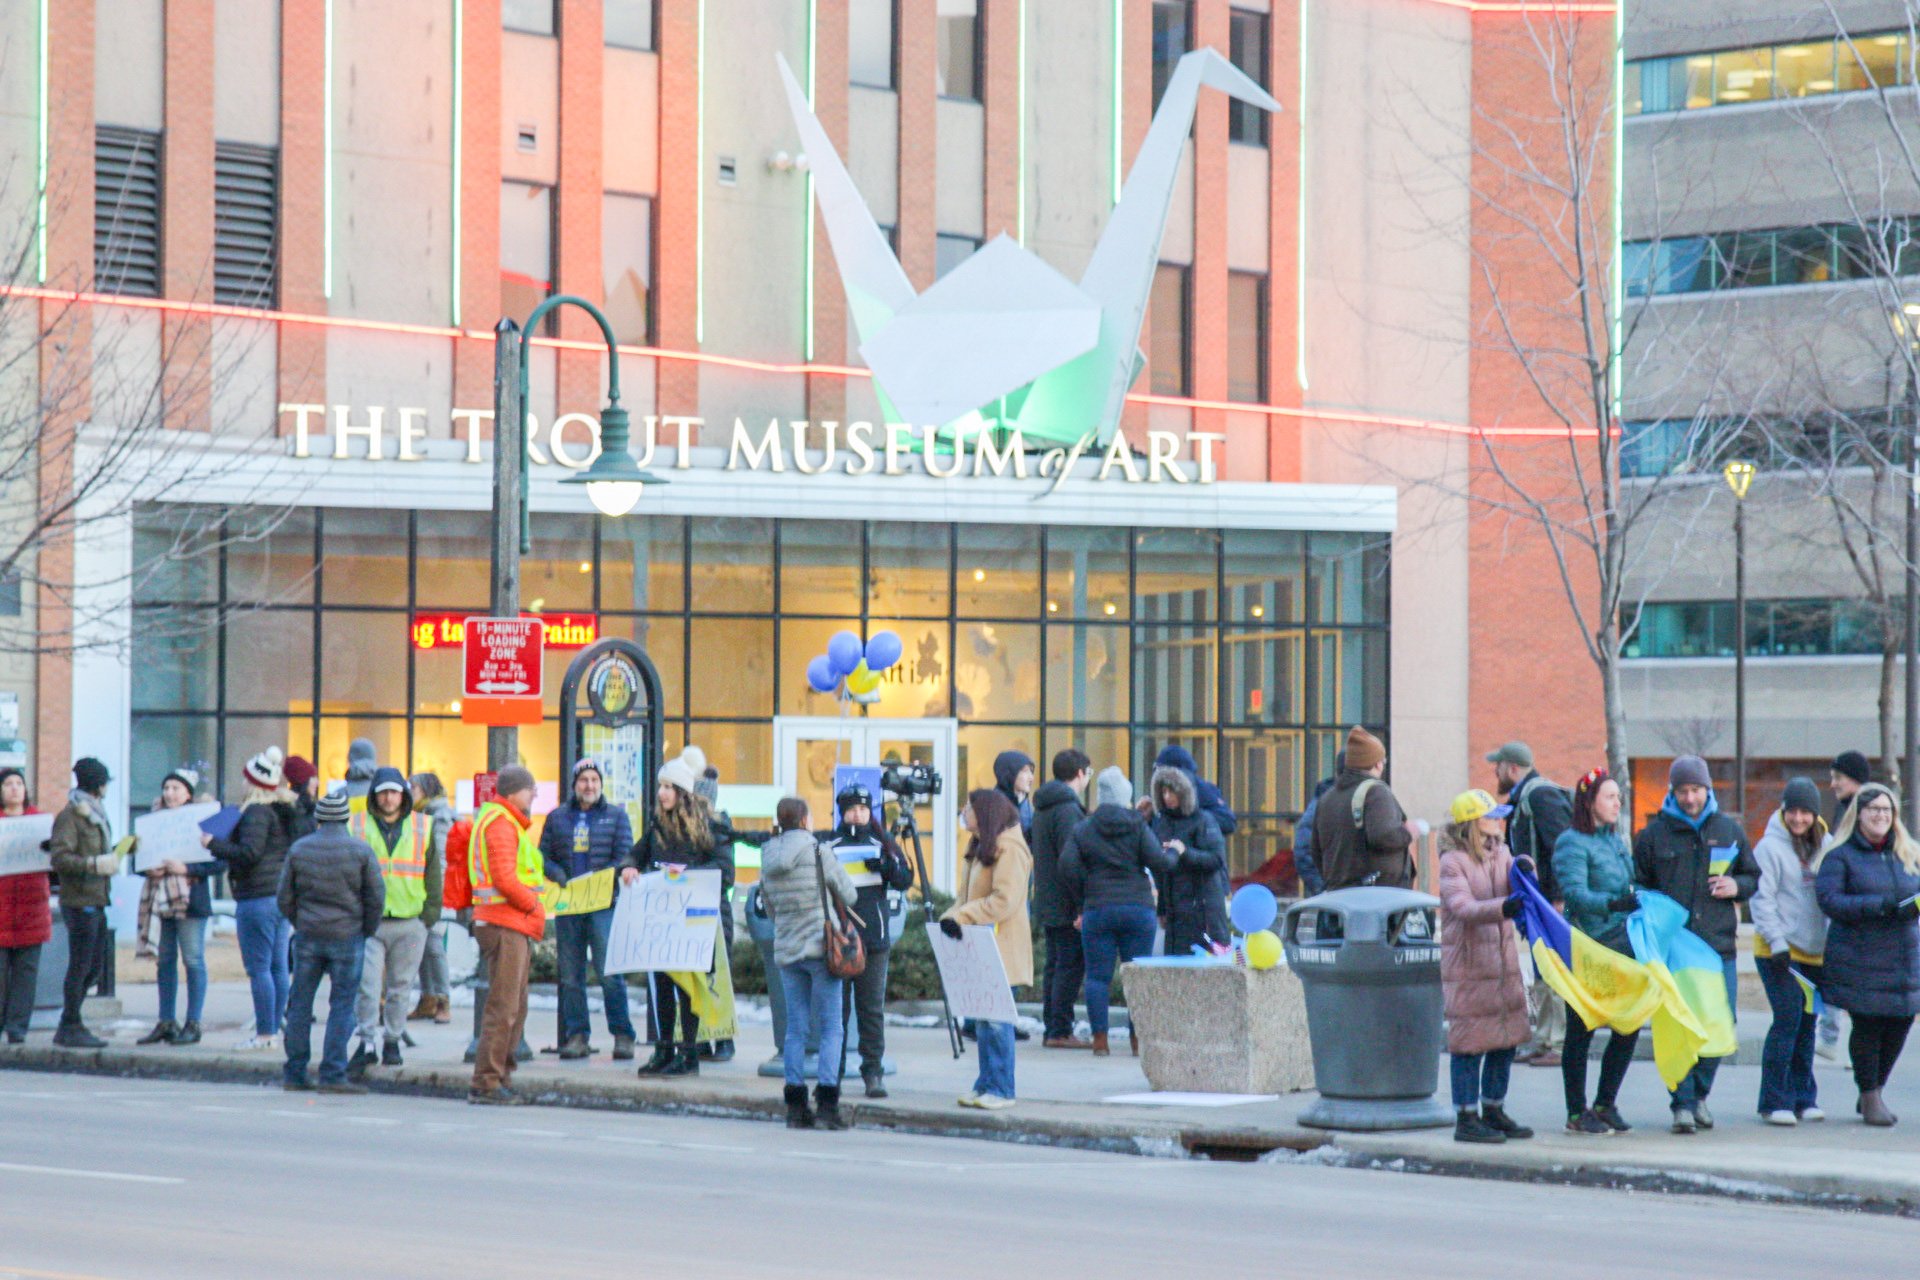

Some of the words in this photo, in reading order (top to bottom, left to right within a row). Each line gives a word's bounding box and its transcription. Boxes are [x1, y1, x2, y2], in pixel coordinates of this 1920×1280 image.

[278, 402, 428, 462] THE
[725, 416, 1028, 479] MUSEUM
[1033, 427, 1098, 500] of
[1099, 429, 1227, 485] ART
[481, 634, 527, 649] LOADING
[489, 647, 518, 660] ZONE
